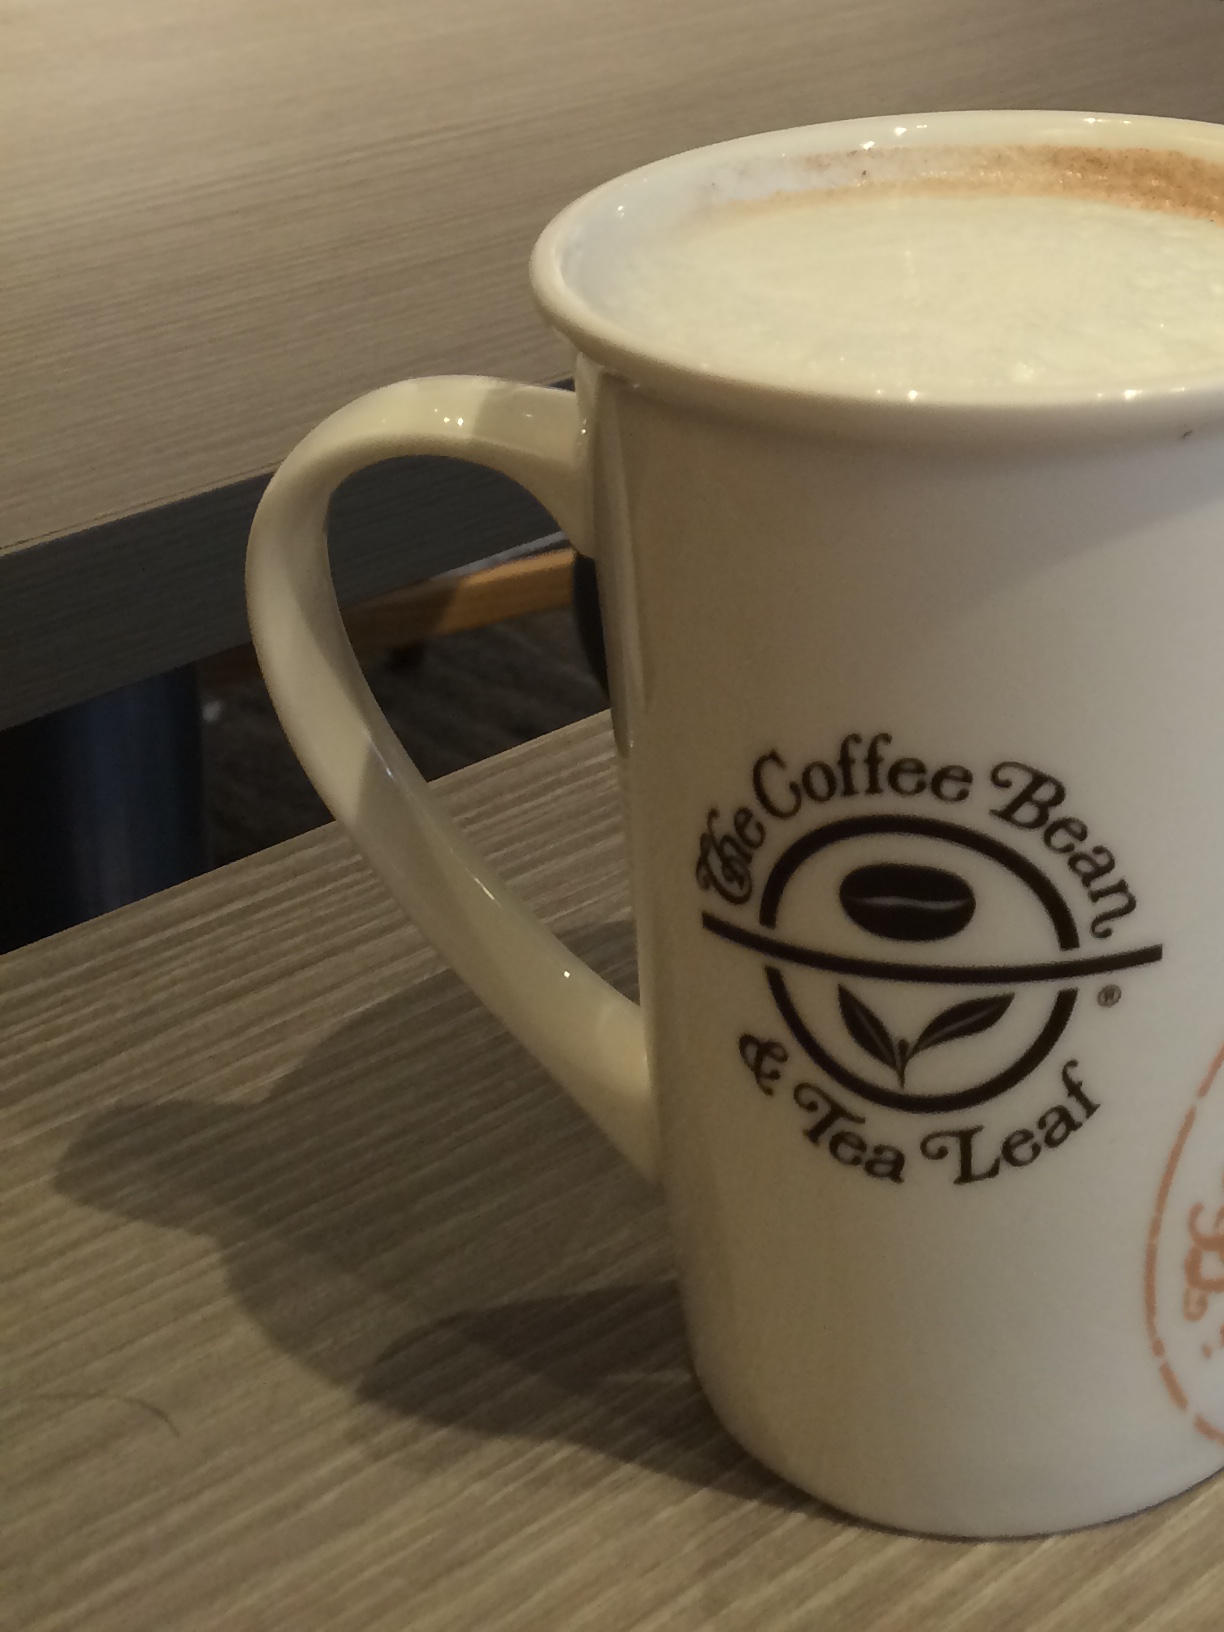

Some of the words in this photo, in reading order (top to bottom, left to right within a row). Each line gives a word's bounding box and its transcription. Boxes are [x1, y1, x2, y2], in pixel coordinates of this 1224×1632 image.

[696, 808, 766, 906] The
[752, 733, 975, 821] Coffee
[988, 761, 1138, 940] Bean
[738, 1033, 789, 1097] &
[793, 1082, 906, 1185] Tea
[920, 1059, 1102, 1186] Leaf
